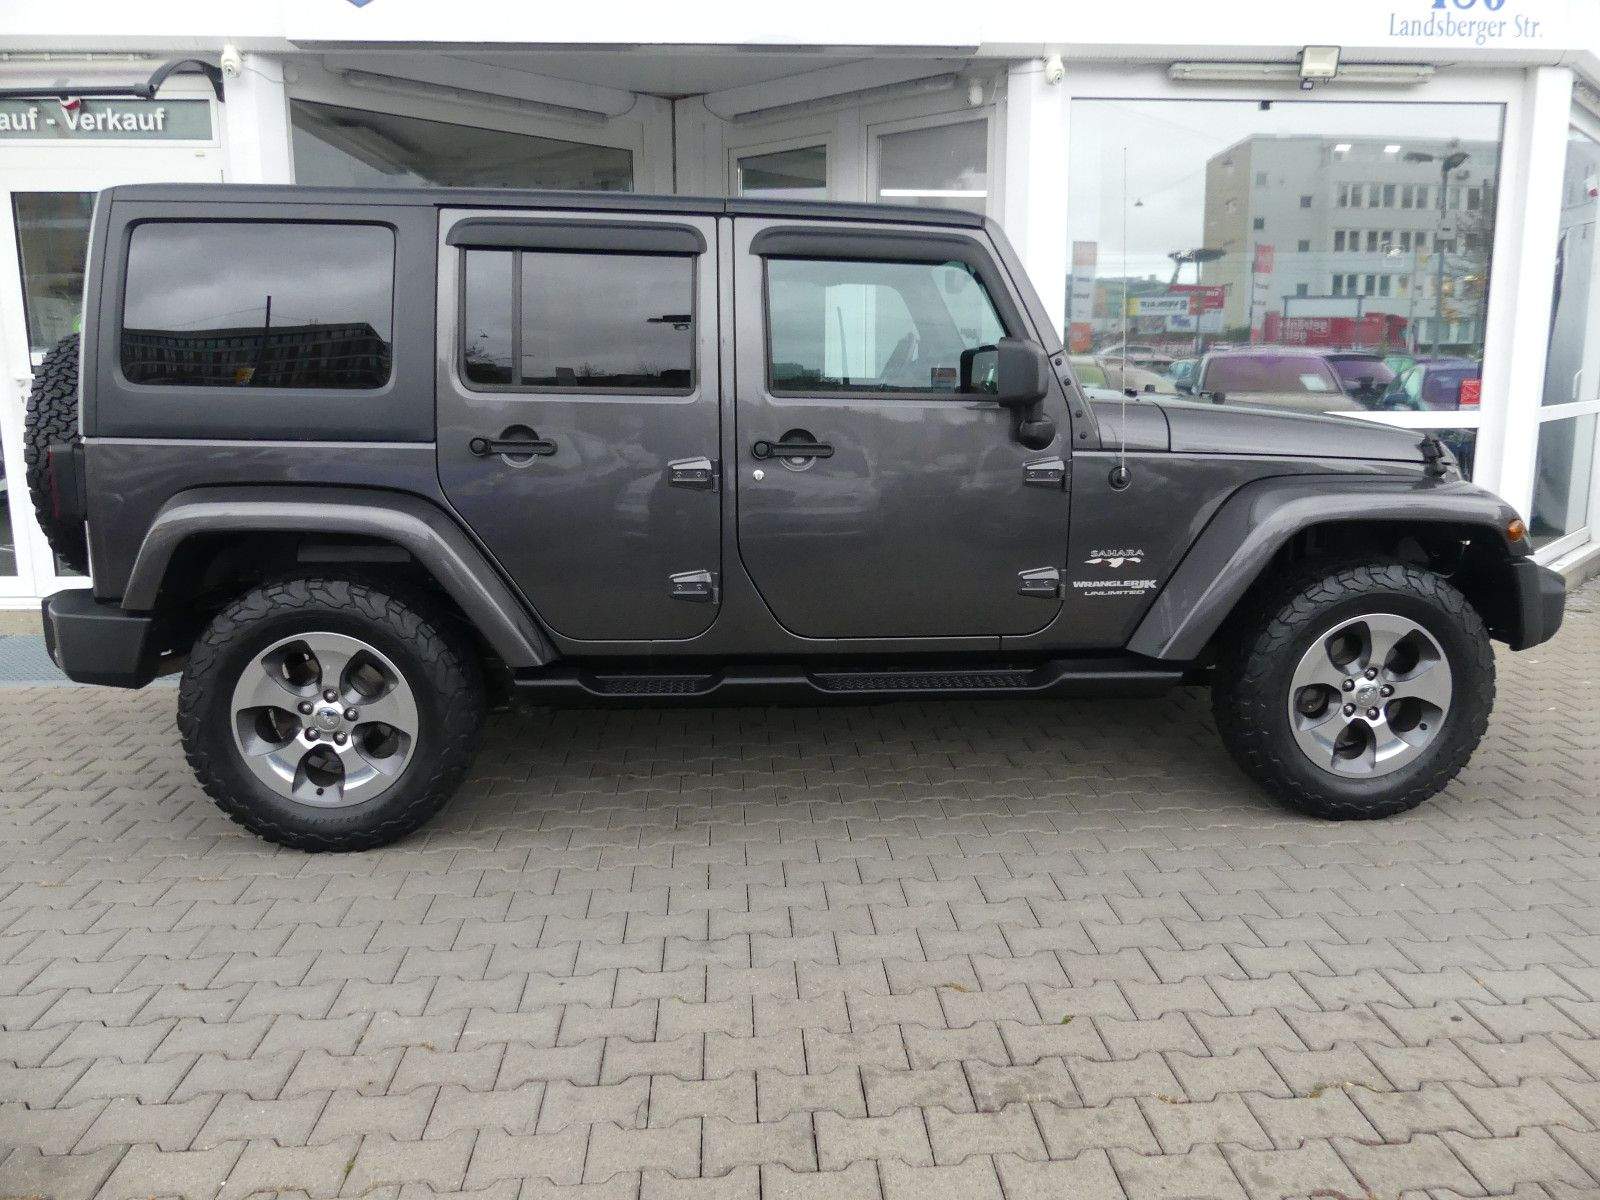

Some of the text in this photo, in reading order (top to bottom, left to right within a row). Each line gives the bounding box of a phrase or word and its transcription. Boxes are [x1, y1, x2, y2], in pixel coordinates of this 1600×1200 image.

[1389, 12, 1543, 45] Landsberger Str.
[62, 107, 165, 131] Verkauf
[1090, 549, 1144, 557] SAHARA
